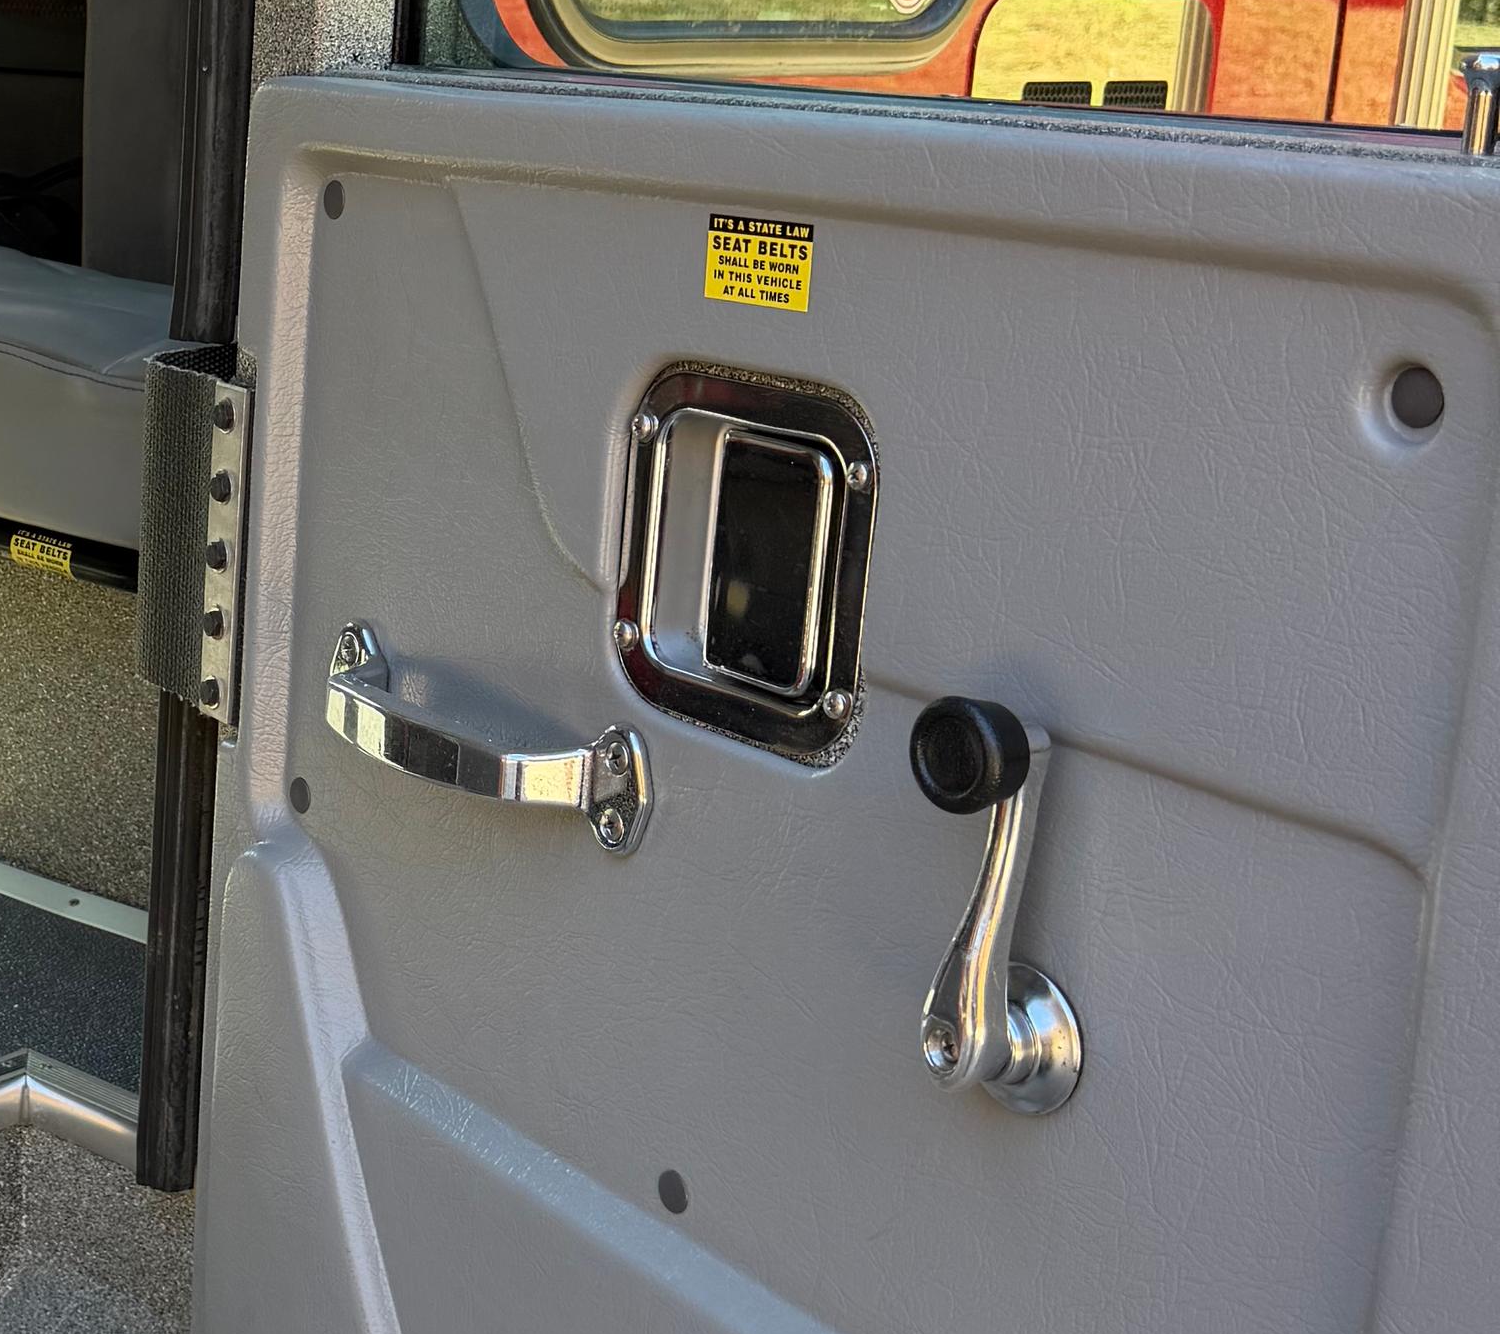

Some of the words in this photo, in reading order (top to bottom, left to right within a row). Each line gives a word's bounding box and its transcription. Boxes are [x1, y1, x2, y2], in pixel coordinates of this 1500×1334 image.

[713, 217, 733, 230] IT'S
[737, 220, 745, 231] A
[749, 222, 782, 235] STATE
[786, 225, 810, 238] LAW
[712, 235, 751, 254] SEAT
[758, 240, 808, 261] BELTS
[718, 255, 749, 269] SHALL
[752, 259, 765, 271] BE
[769, 262, 799, 275] WORN
[713, 269, 724, 280] IN
[728, 271, 752, 283] THIS
[757, 275, 802, 290] VEHICLE
[723, 285, 735, 296] AT
[738, 287, 756, 299] ALL
[759, 290, 790, 304] TIMES
[13, 538, 37, 551] SEAT
[40, 545, 68, 560] BELTS
